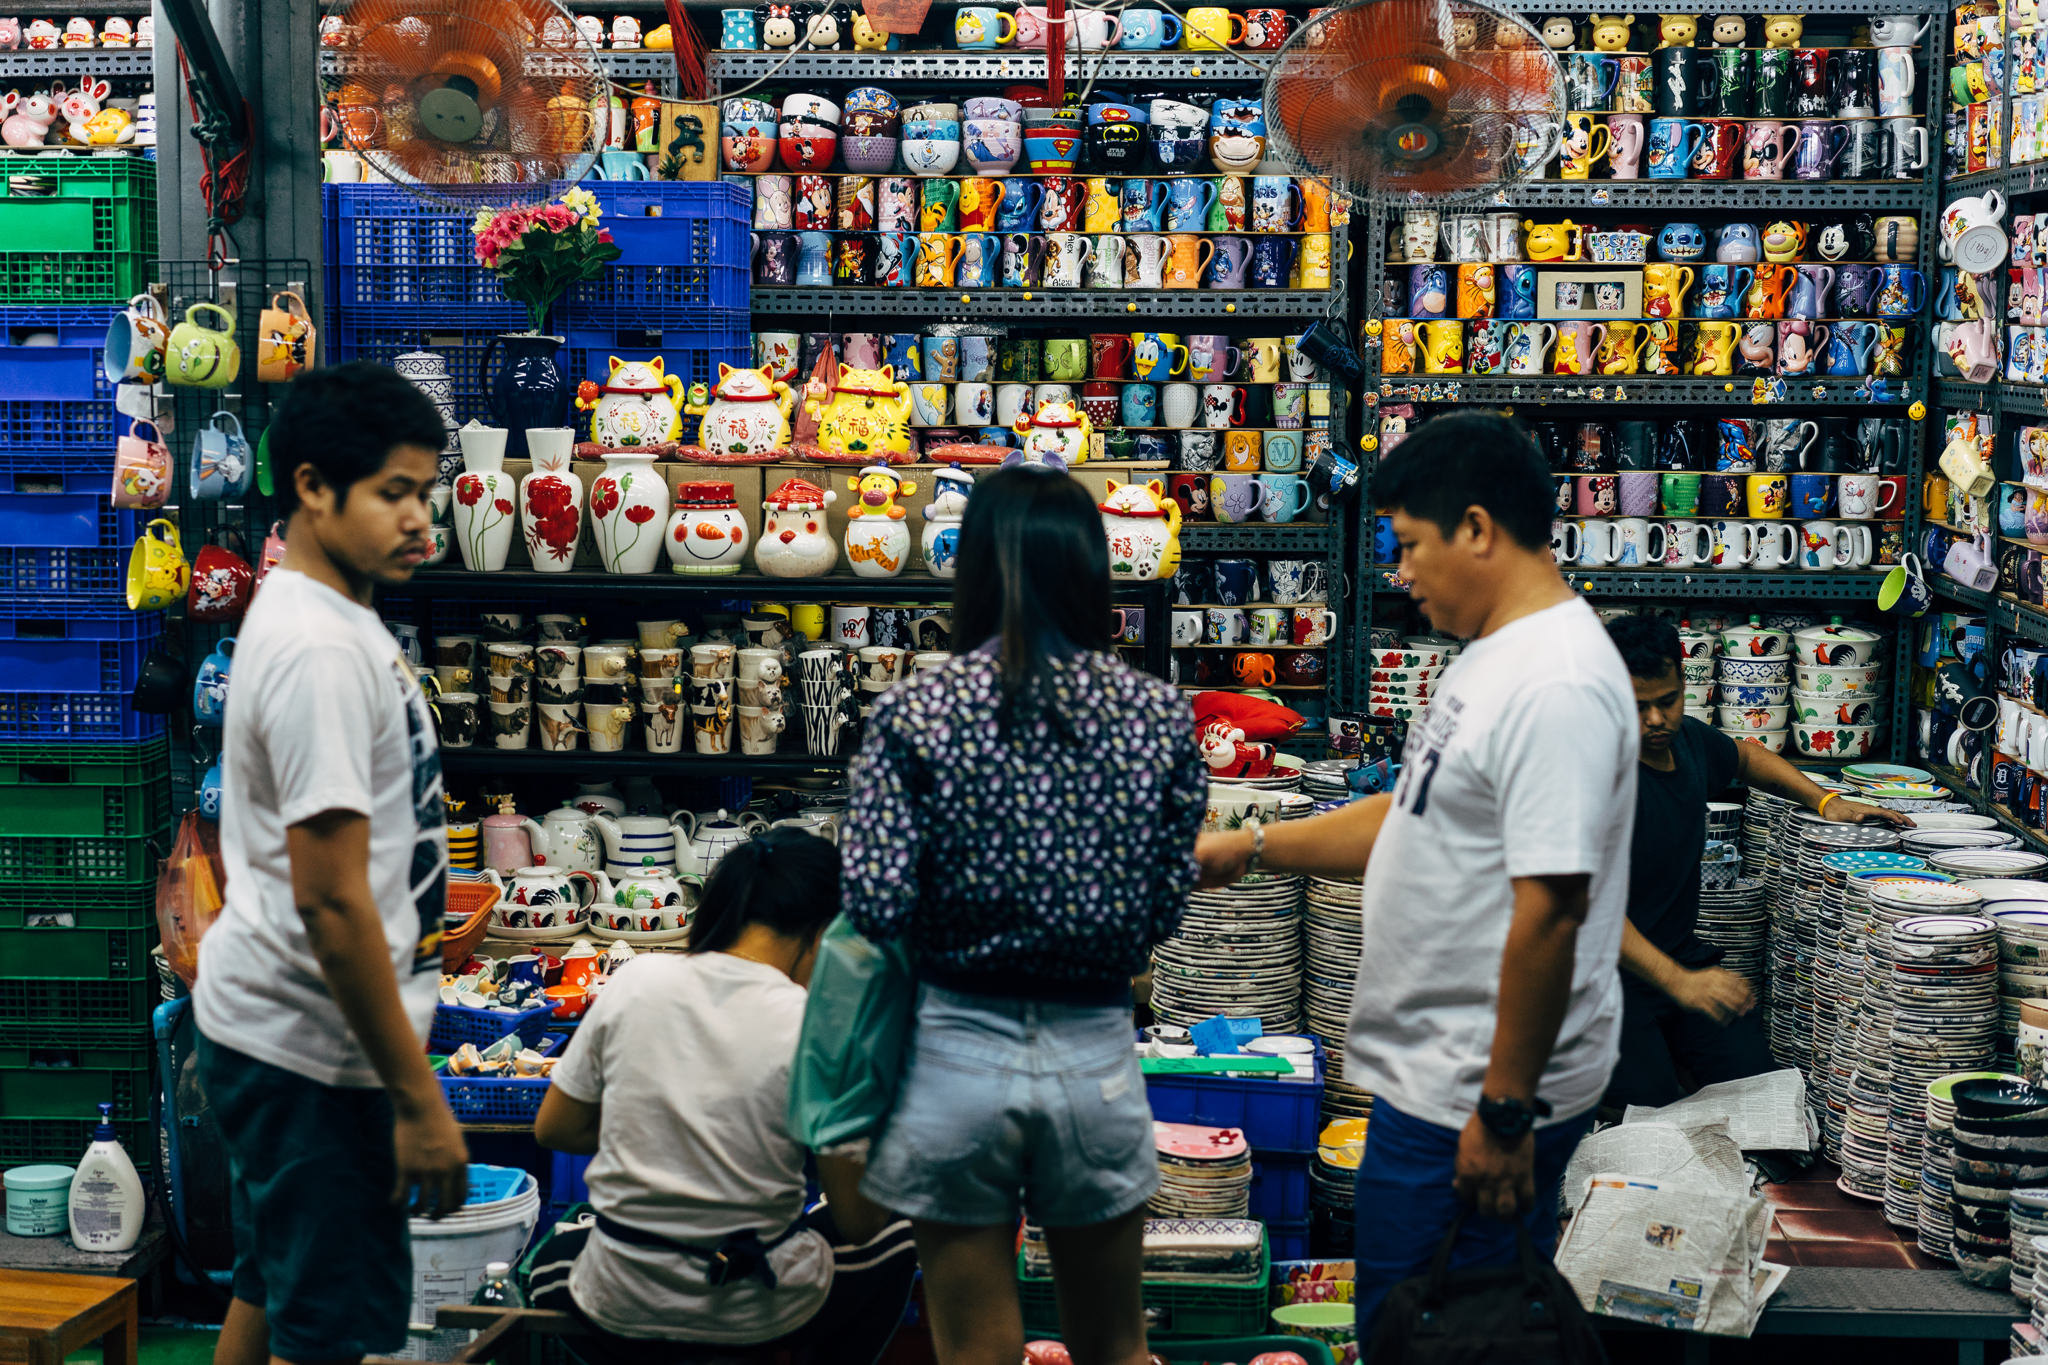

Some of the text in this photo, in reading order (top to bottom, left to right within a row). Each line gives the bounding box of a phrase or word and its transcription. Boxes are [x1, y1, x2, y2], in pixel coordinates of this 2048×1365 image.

[1067, 234, 1075, 255] Alex
[619, 411, 640, 431] 福
[727, 418, 749, 439] 福
[848, 416, 869, 437] 福
[1271, 442, 1291, 462] M
[1111, 536, 1134, 559] 福
[842, 622, 857, 631] LO
[842, 629, 857, 639] VE
[1231, 1021, 1250, 1032] 50
